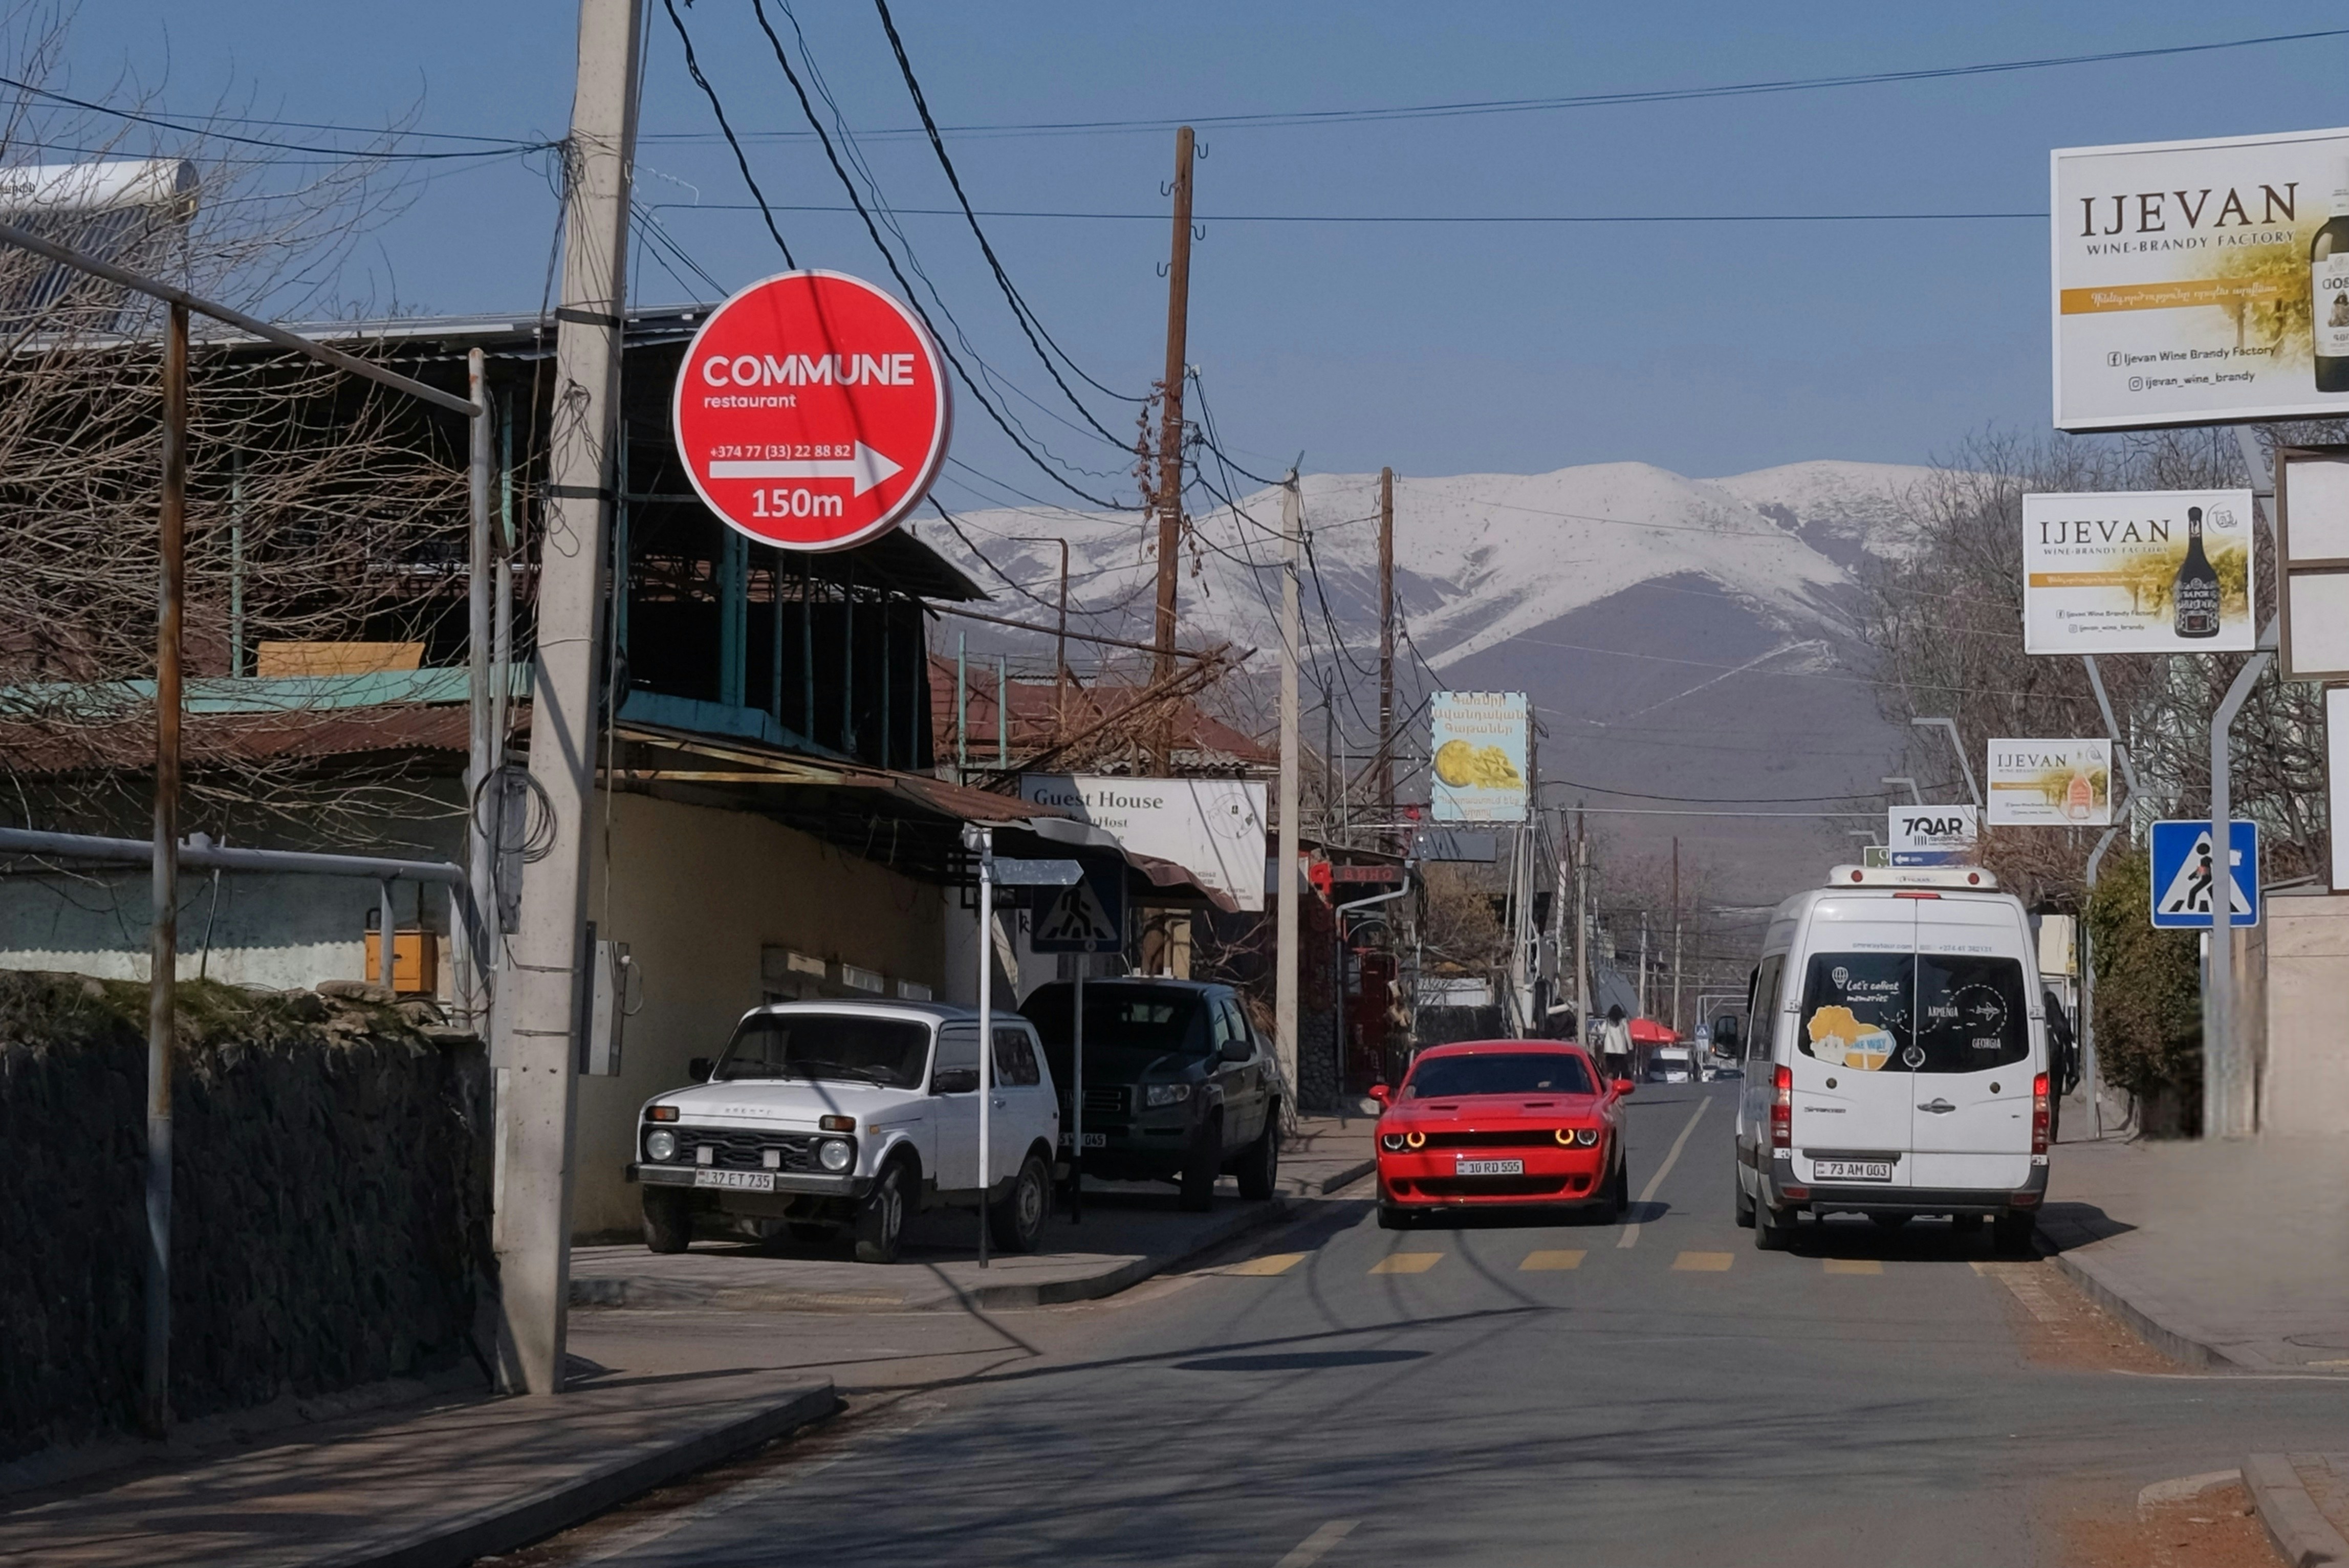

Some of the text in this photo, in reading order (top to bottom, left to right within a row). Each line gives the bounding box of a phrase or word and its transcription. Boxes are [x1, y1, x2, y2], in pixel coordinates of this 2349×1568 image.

[2080, 182, 2299, 237] IJEVAN
[2086, 231, 2294, 255] WINE-BRANDY FACTORY
[2124, 346, 2276, 366] Ijevan Wine Brandy Factory
[703, 353, 915, 387] COMMUNE
[2145, 371, 2255, 389] ijevan_wine_brandy
[704, 394, 797, 408] restaurant
[710, 444, 851, 460] +374 77 (33) 22 88 82
[752, 489, 843, 517] 150m
[2039, 519, 2171, 545] IJEVAN
[1997, 753, 2067, 767] IJEVAN
[1034, 789, 1164, 809] Guest House
[1902, 817, 1963, 836] 7QAR
[1846, 979, 1868, 991] Let's
[1484, 1162, 1498, 1173] RD
[1501, 1162, 1519, 1172] 555
[1830, 1163, 1887, 1176] 73 AM 003
[729, 1173, 746, 1186] ET
